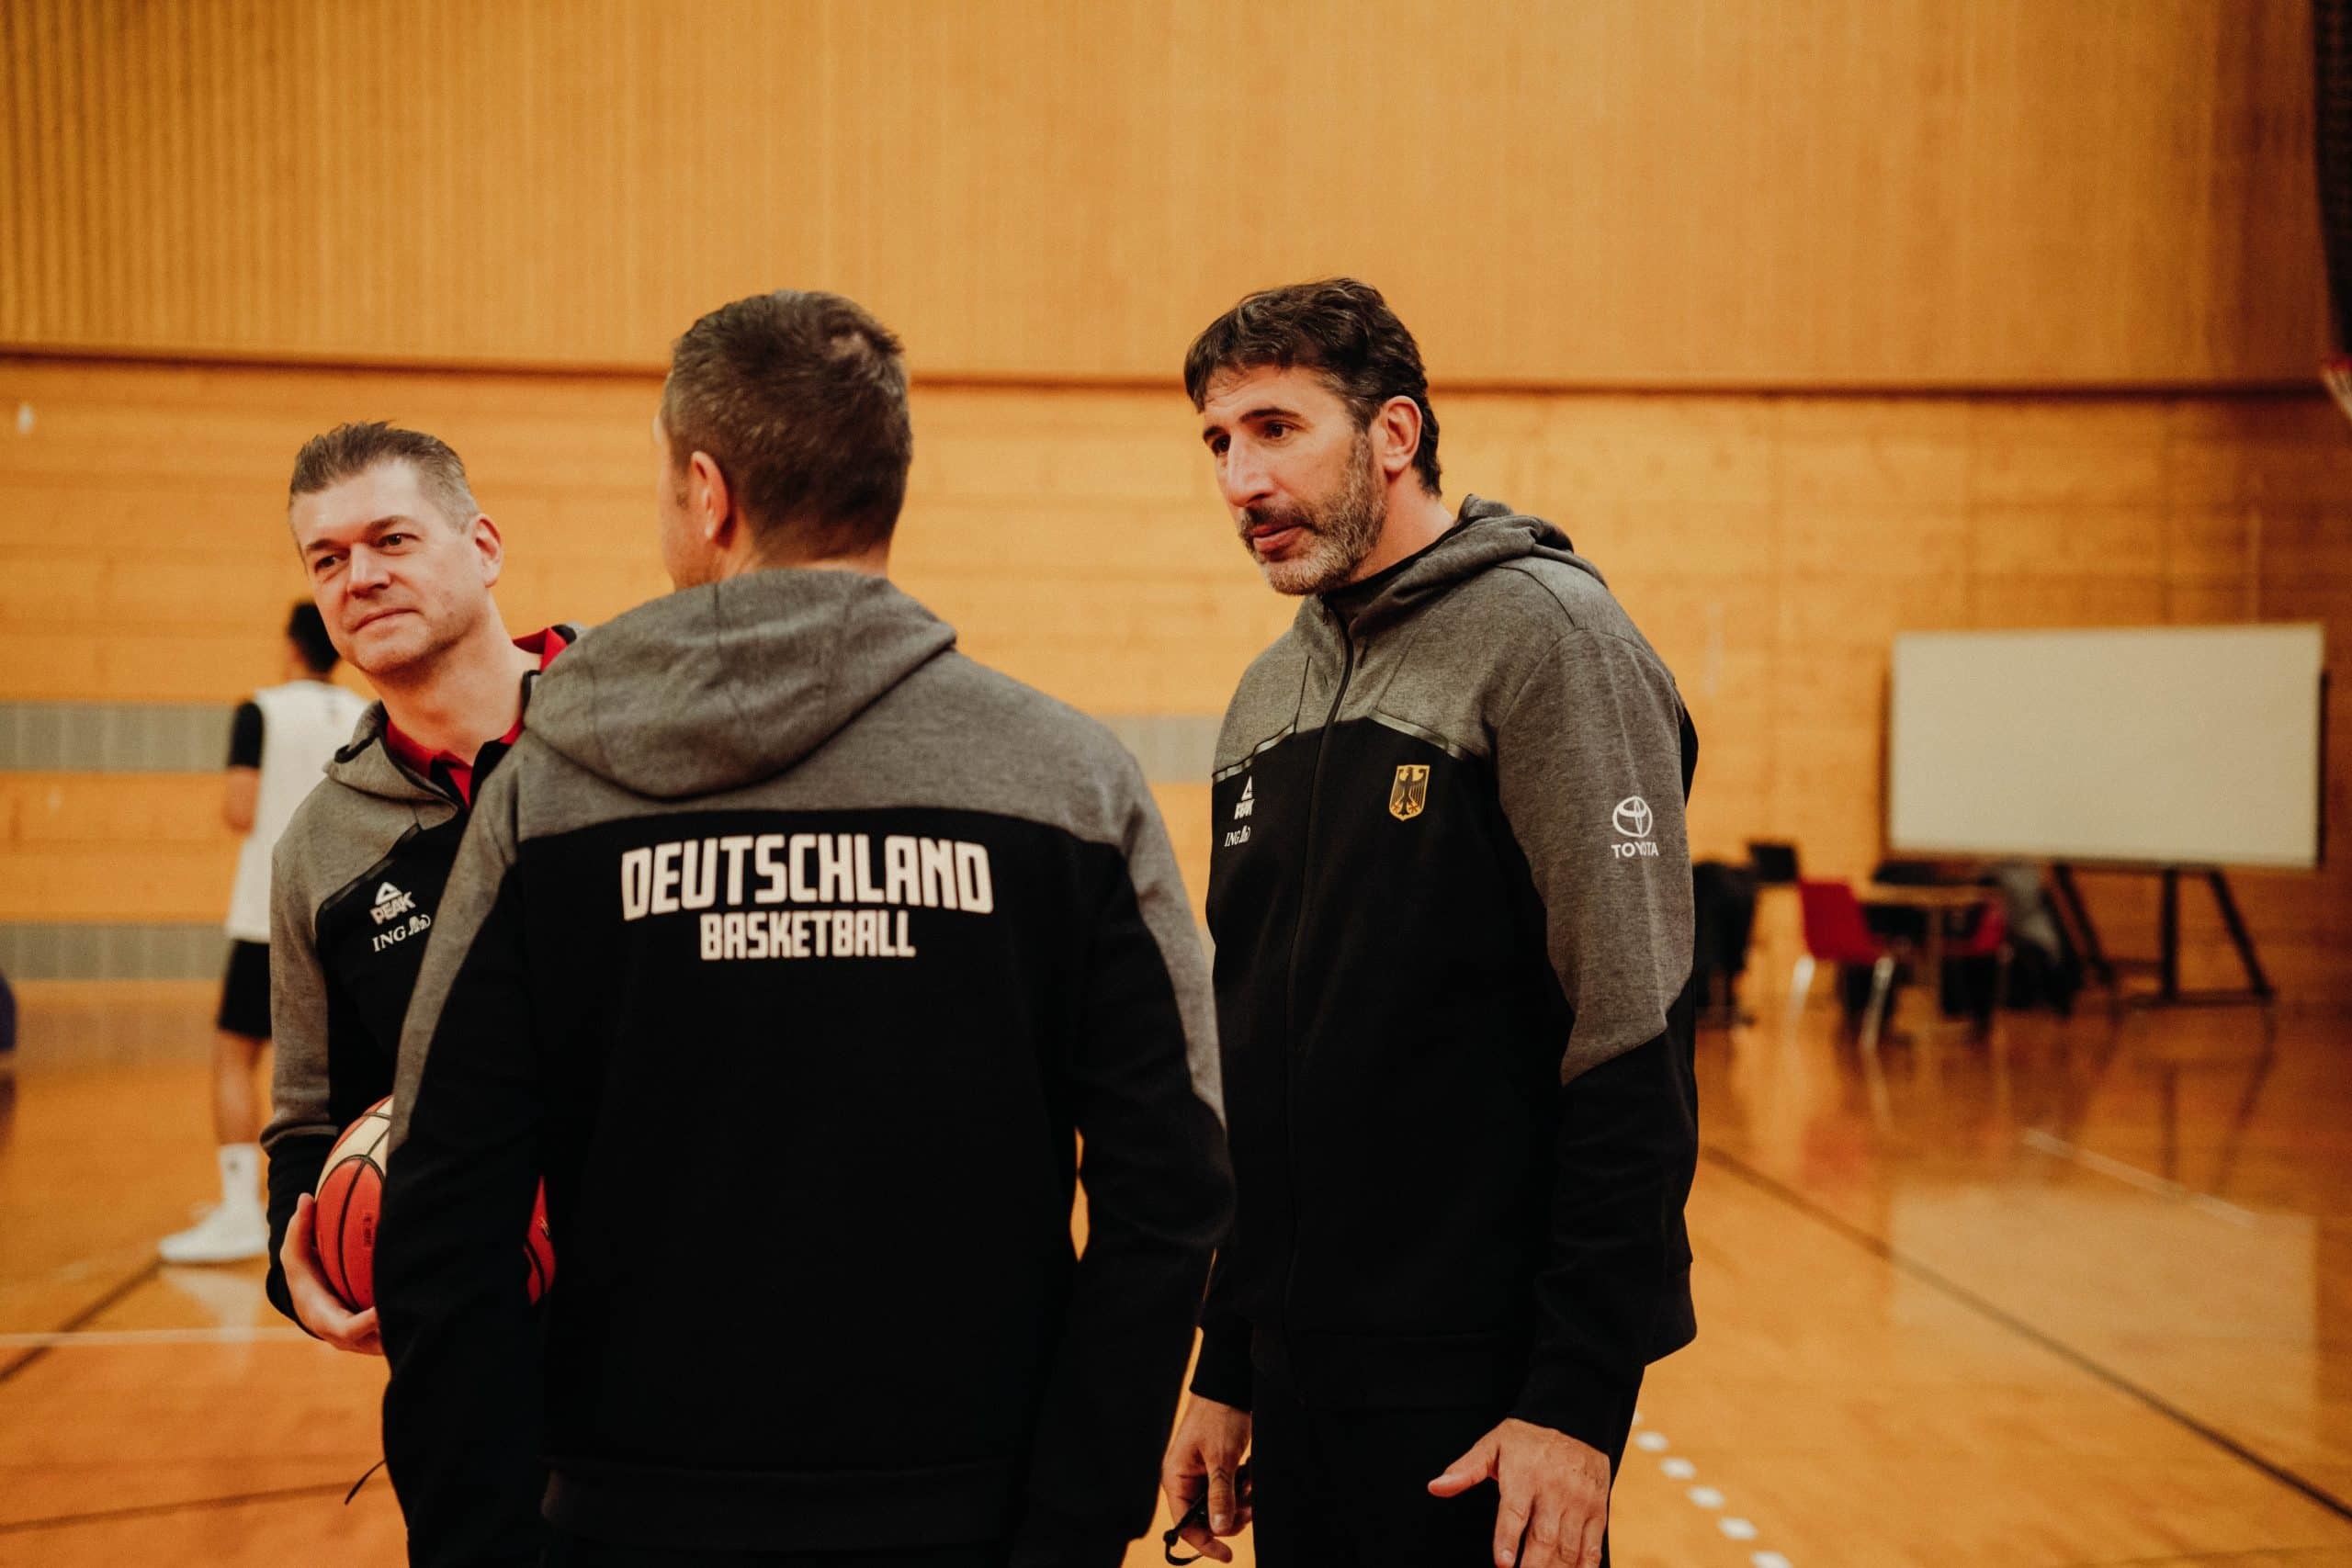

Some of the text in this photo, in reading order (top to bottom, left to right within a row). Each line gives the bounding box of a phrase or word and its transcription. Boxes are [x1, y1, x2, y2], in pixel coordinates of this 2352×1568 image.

[1224, 830, 1241, 846] ING
[1611, 841, 1659, 858] TOYOTA
[621, 833, 994, 921] DEUTSCHLAND
[369, 891, 416, 926] PEAK
[372, 925, 406, 953] ING
[700, 909, 916, 960] BASKETBALL
